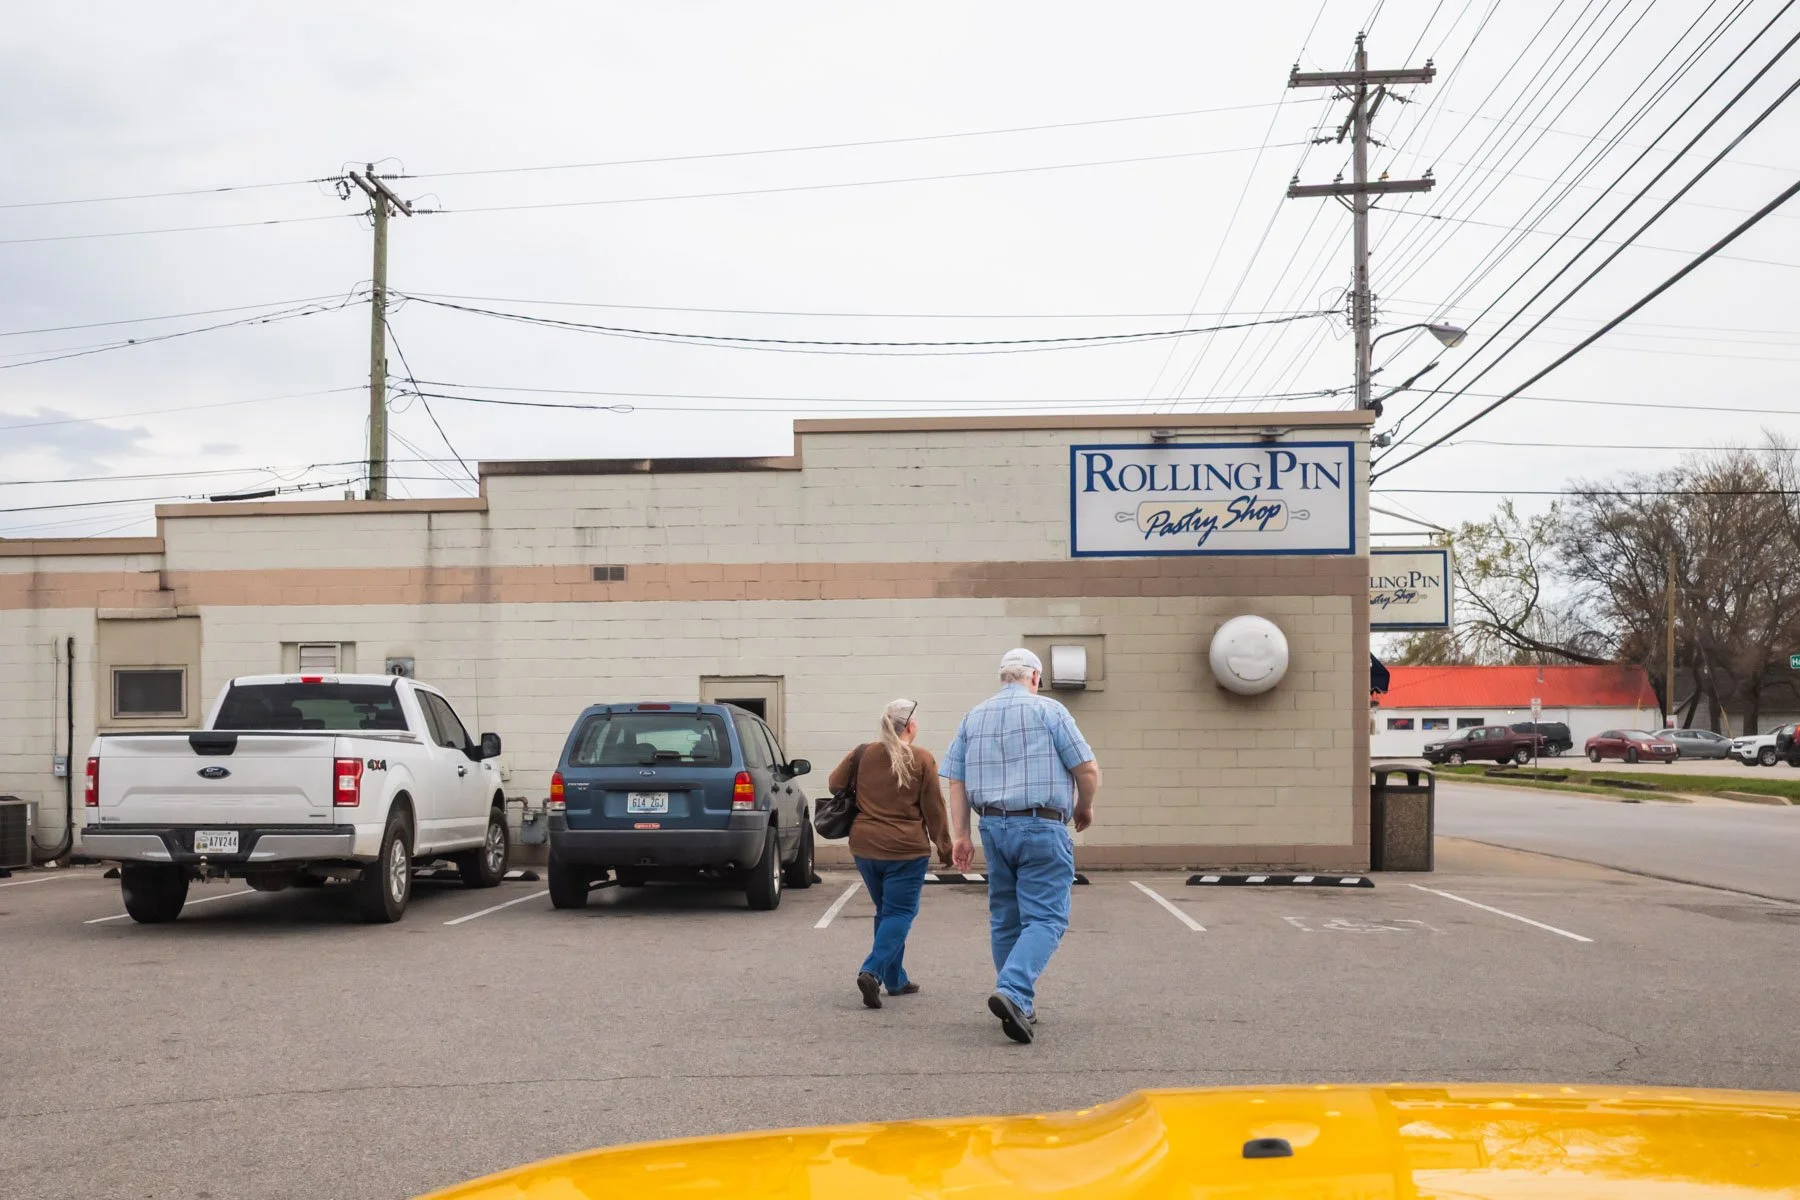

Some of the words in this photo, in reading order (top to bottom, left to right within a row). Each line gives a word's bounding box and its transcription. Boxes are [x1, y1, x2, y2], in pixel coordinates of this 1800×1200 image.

[1144, 506, 1219, 548] Pastry
[1222, 495, 1283, 531] Shop
[1370, 571, 1440, 588] LINGPIN
[1391, 589, 1417, 604] Shop
[632, 798, 646, 808] 614
